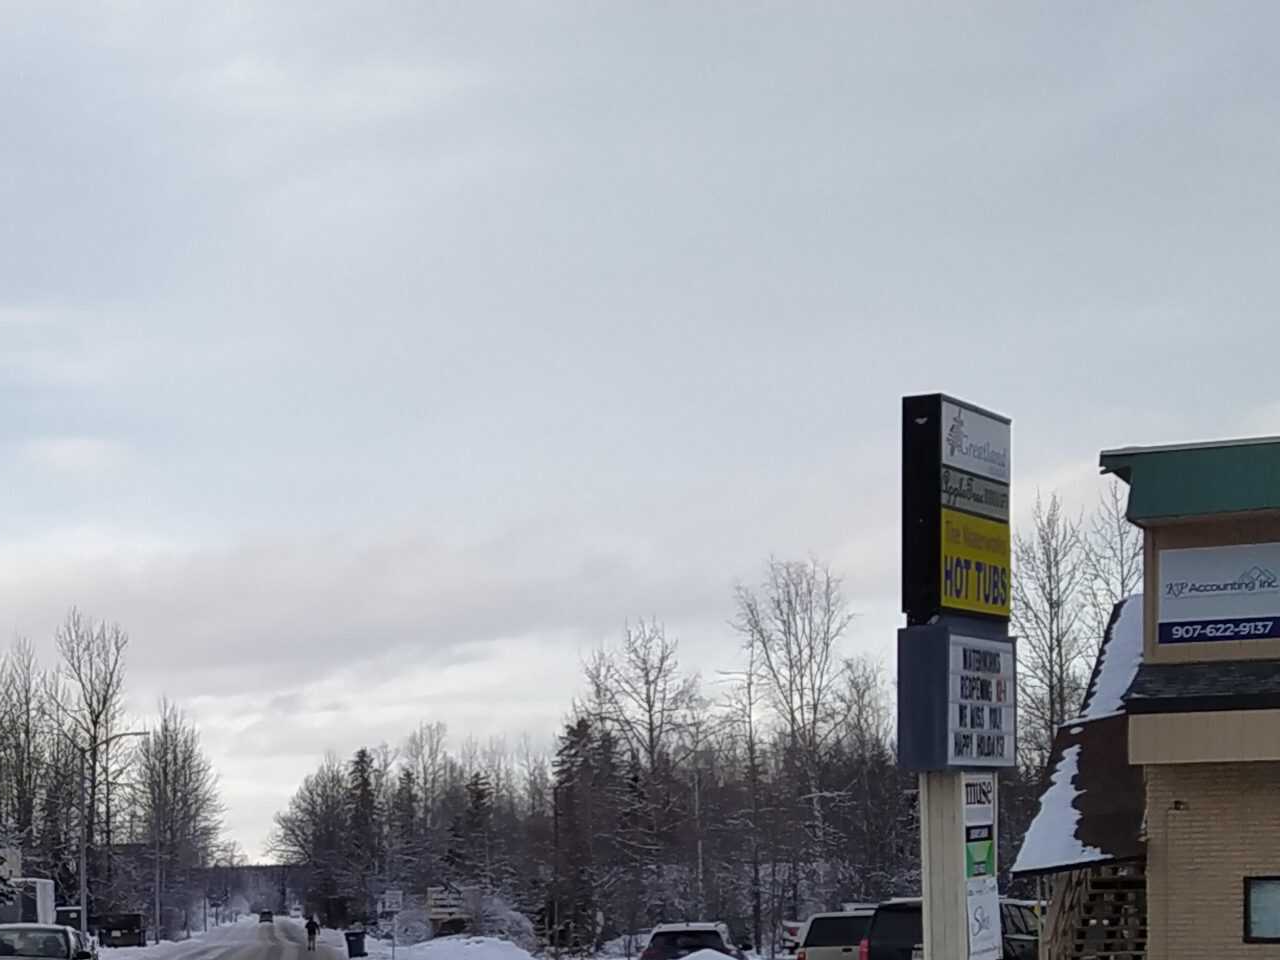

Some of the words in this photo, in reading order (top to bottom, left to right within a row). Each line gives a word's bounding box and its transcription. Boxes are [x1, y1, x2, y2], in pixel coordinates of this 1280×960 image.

[944, 555, 971, 600] HOT
[976, 561, 1007, 606] TUBS
[1189, 581, 1256, 592] Accounting
[1172, 622, 1273, 638] 907-622-9137
